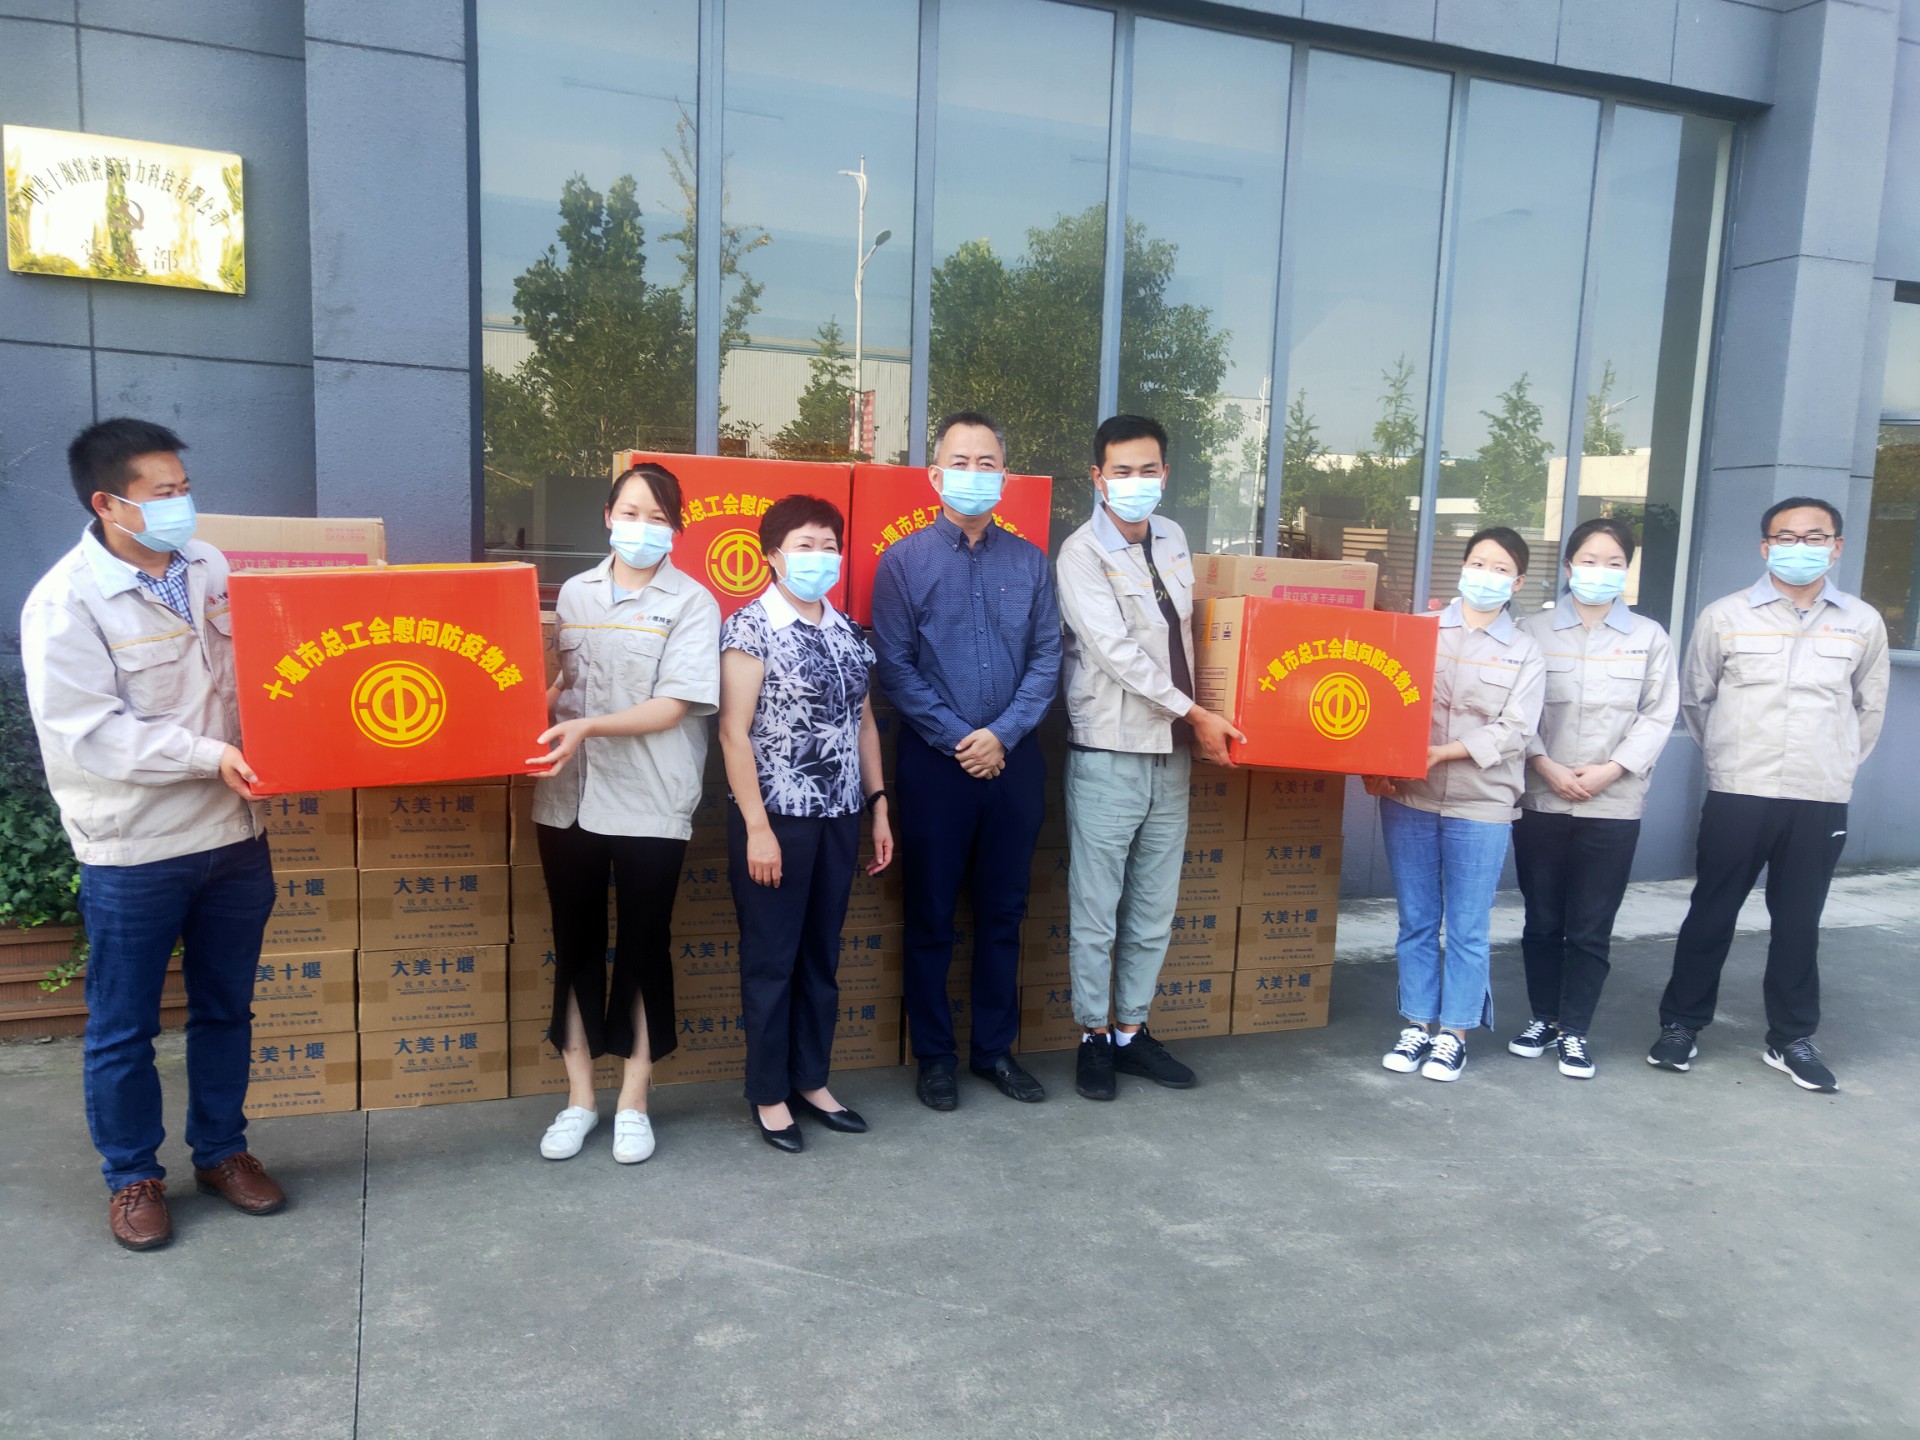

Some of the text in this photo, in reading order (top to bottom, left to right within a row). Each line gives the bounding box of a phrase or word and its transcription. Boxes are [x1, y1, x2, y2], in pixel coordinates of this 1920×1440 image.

[263, 616, 523, 700] 十堰市总工会慰问防疫物资
[1258, 637, 1421, 706] 十堰市总工会慰问防疫物资
[1271, 779, 1325, 794] 大美十堰
[389, 795, 475, 814] 大美十堰
[1265, 845, 1322, 860] 大美十堰
[274, 878, 325, 897] 十堰
[393, 874, 478, 895] 大美十堰
[1261, 908, 1318, 925] 大美十堰
[680, 941, 740, 959] 大美十
[390, 955, 475, 978] 大美十堰
[1154, 979, 1212, 997] 大美十堰
[1255, 973, 1311, 991] 大美十堰
[394, 1032, 478, 1056] 大美十堰
